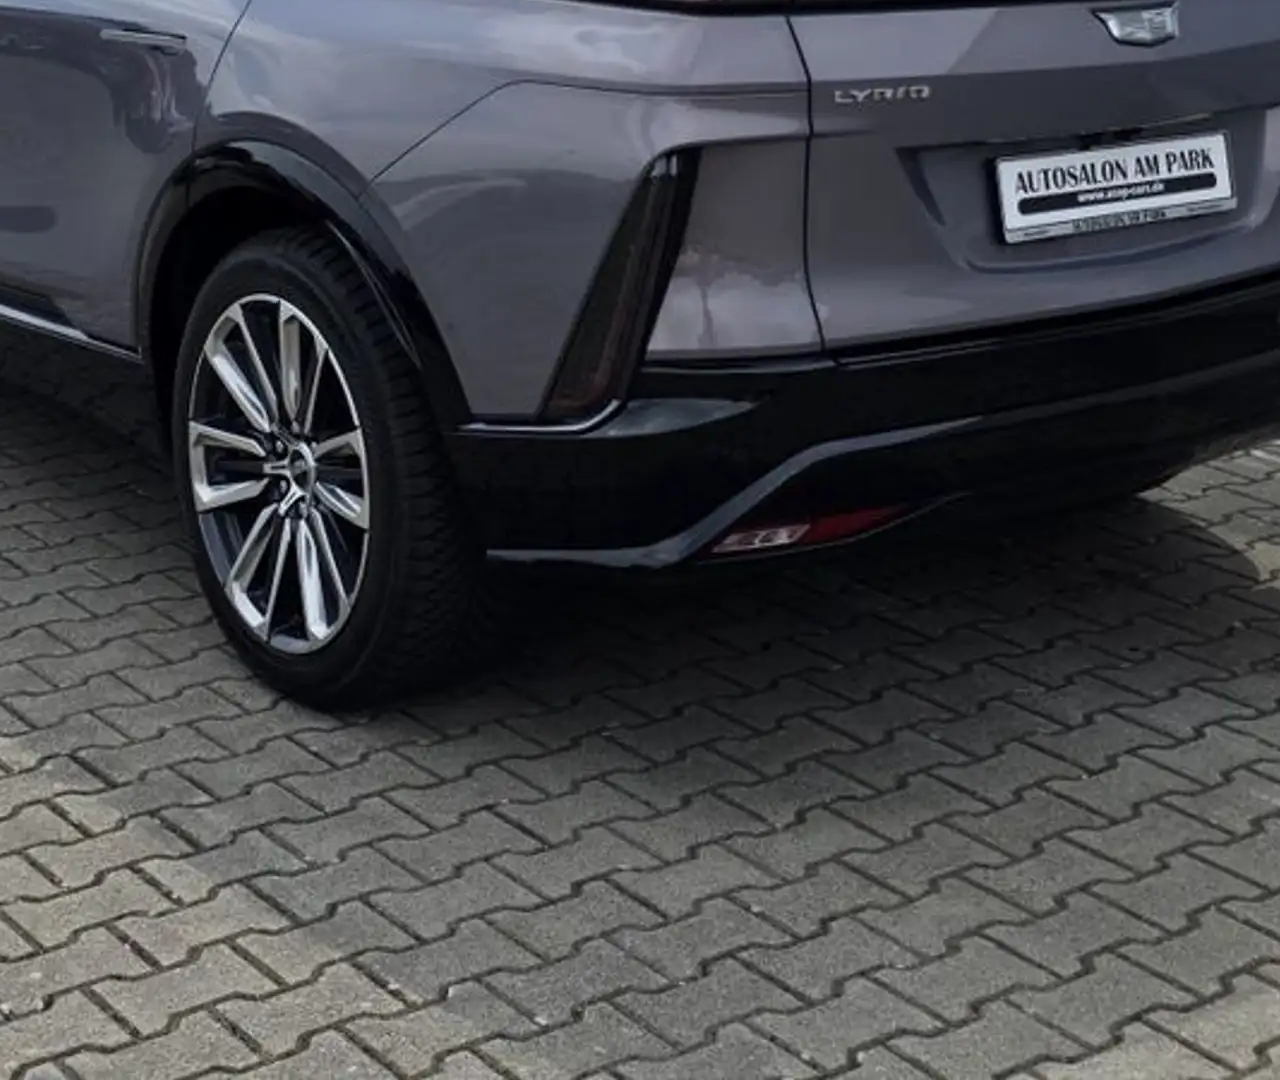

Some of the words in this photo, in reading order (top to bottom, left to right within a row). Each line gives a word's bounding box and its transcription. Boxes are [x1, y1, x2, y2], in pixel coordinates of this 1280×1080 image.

[1015, 158, 1131, 195] AUTOSALON
[1132, 154, 1161, 178] AM
[1165, 147, 1215, 172] PARK
